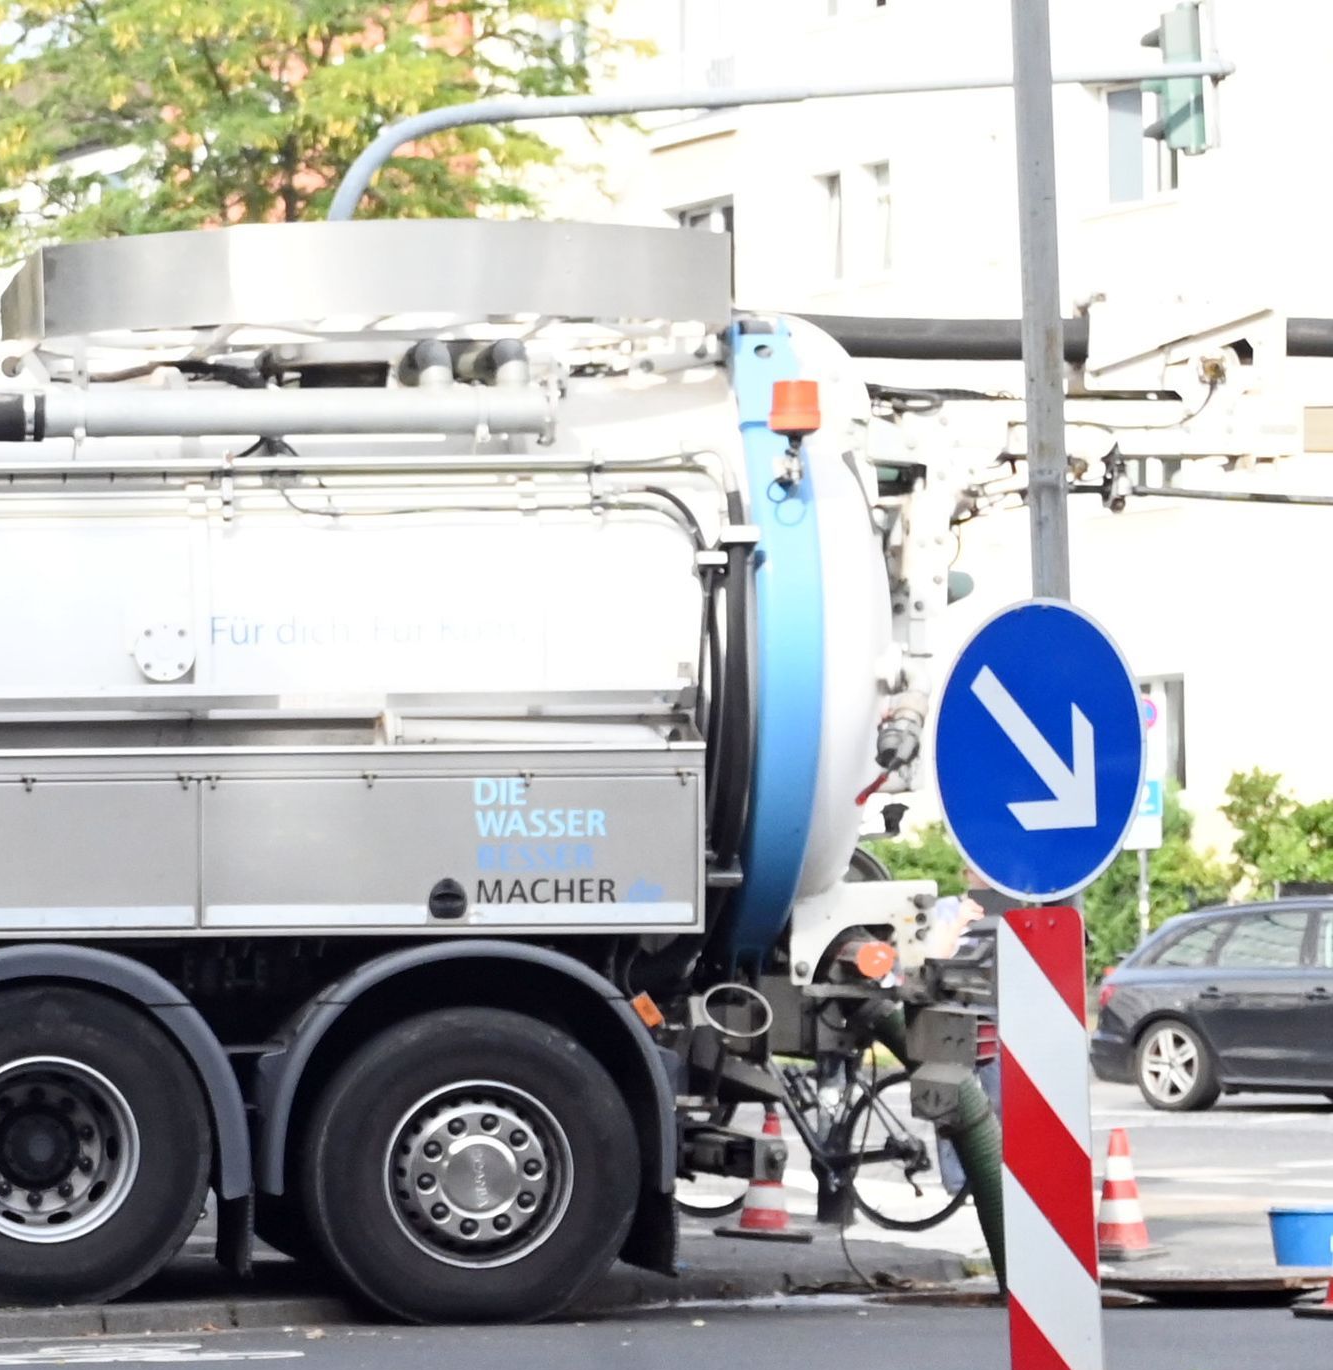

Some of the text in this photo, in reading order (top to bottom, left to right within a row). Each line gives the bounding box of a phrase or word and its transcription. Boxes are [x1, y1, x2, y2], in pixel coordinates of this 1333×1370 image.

[210, 614, 263, 646] Für
[474, 777, 527, 806] DIE
[475, 808, 607, 837] WASSER
[476, 843, 595, 872] BESSER
[476, 878, 617, 904] MACHER
